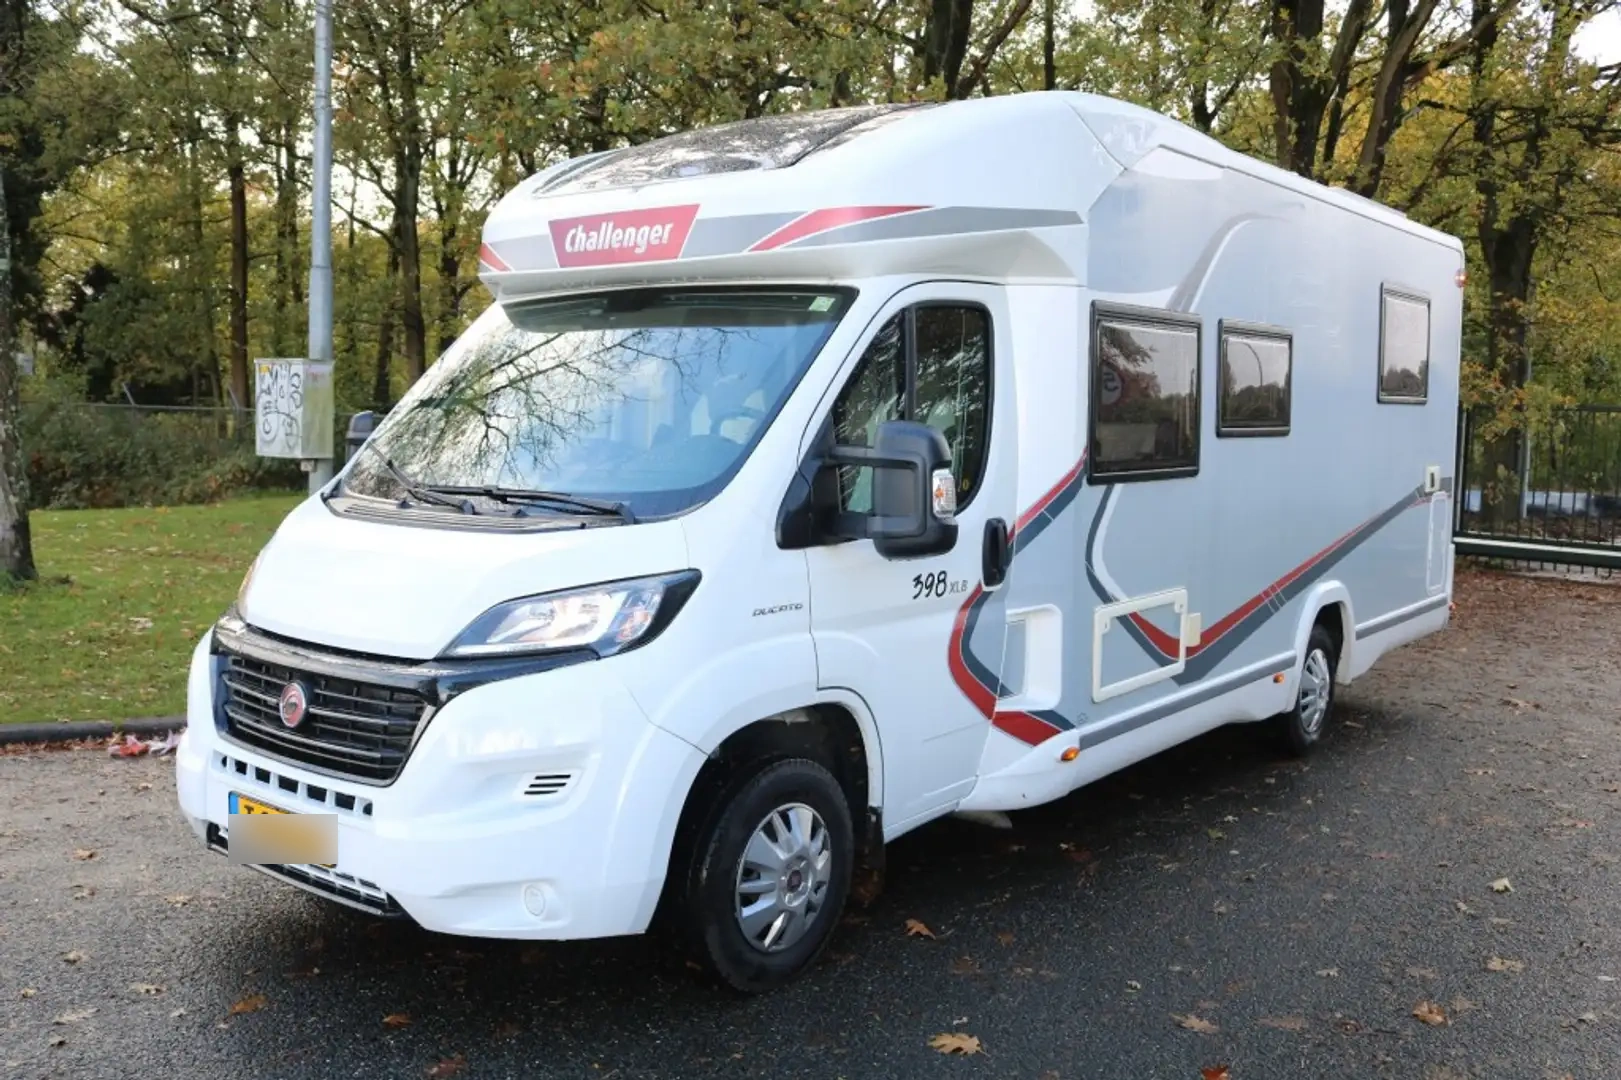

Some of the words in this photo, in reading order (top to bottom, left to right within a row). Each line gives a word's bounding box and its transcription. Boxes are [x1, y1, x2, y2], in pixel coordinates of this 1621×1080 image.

[565, 221, 674, 254] Challenger
[912, 570, 947, 600] 398
[752, 602, 803, 617] DUCATO
